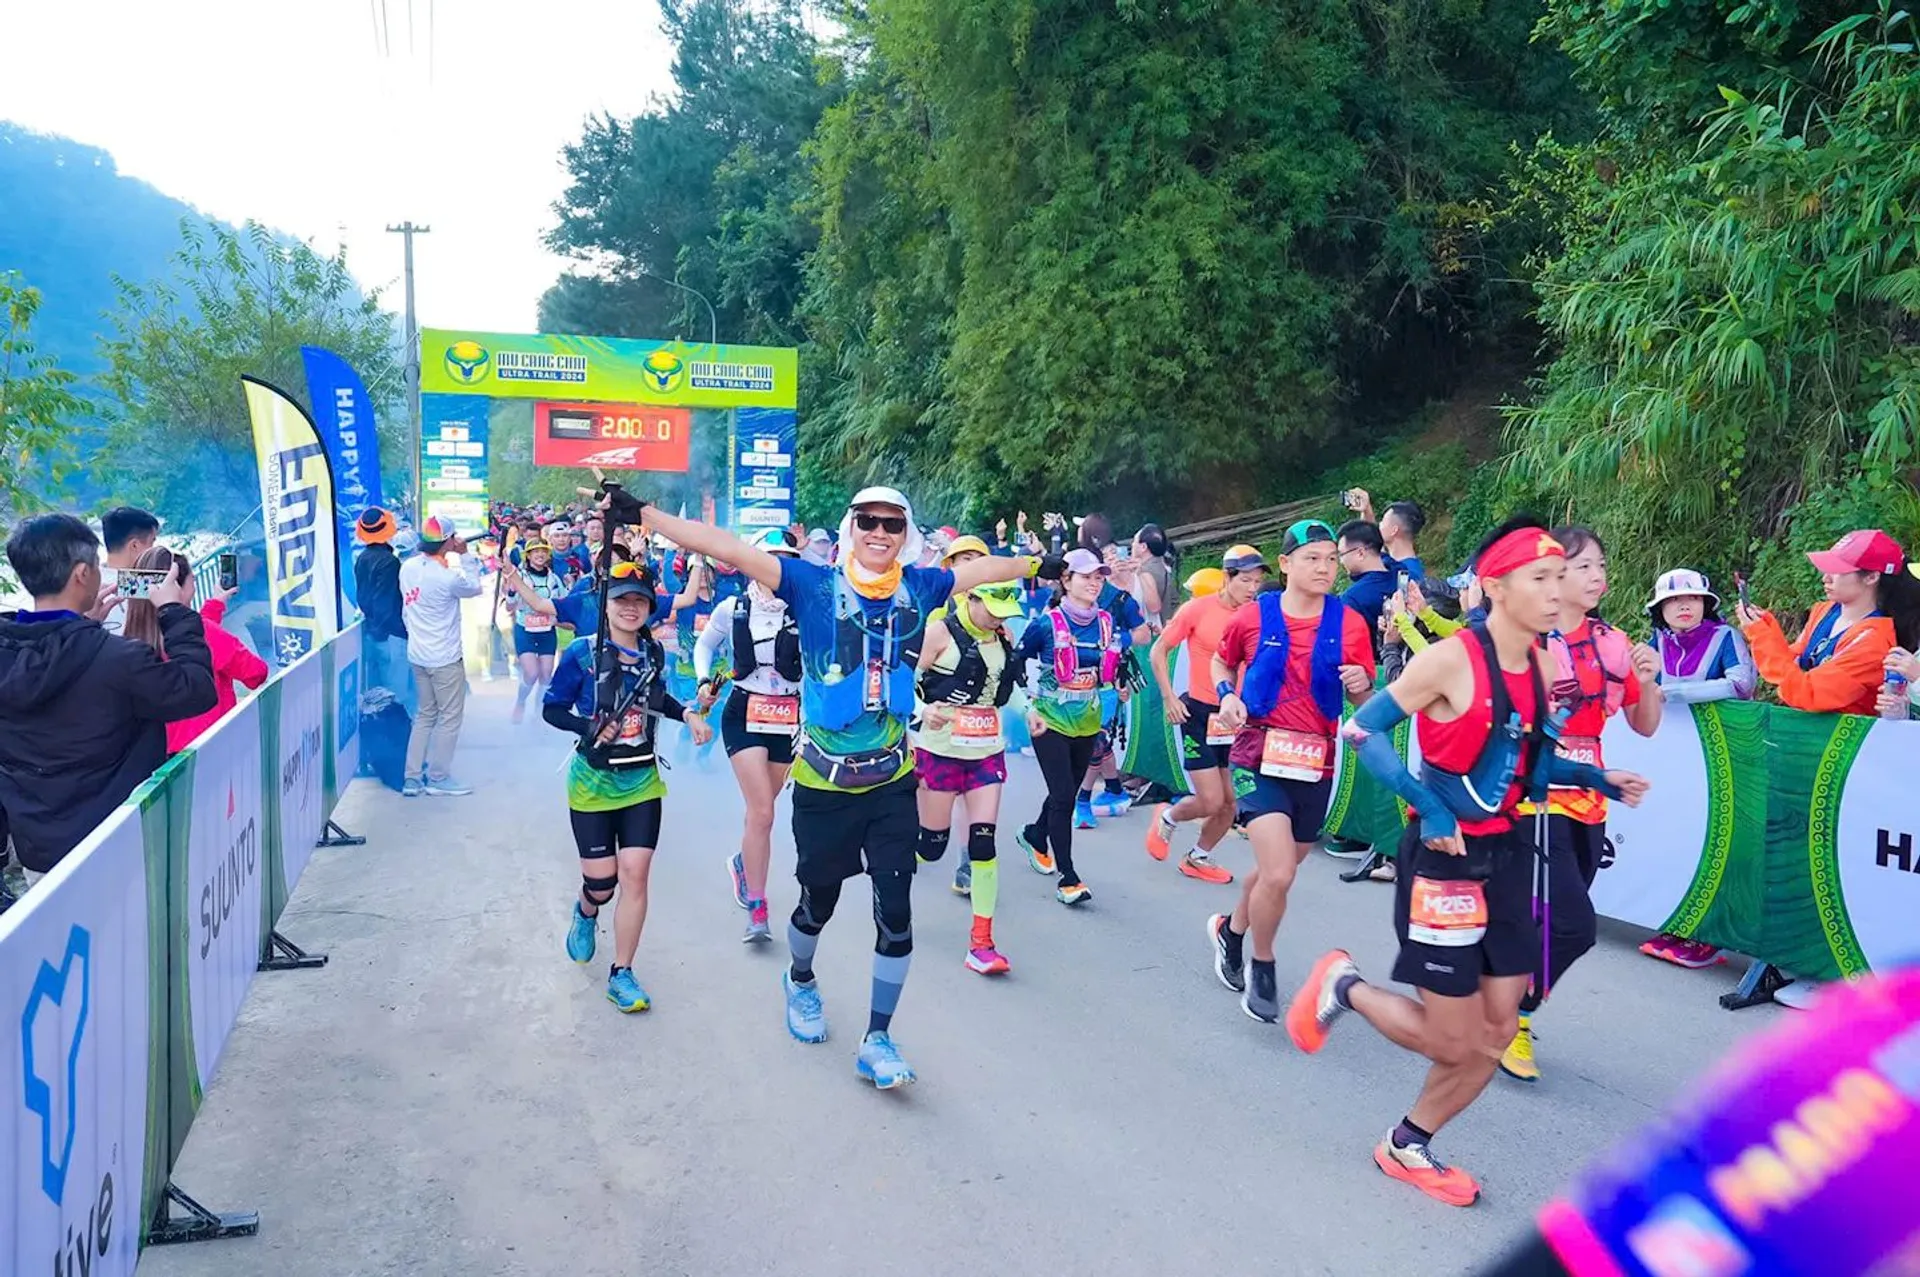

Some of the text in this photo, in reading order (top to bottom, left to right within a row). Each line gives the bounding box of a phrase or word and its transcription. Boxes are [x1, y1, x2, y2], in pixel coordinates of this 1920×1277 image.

[502, 369, 584, 381] ULTRA TRAIL 2024
[694, 378, 771, 390] ULTRA TRAIL 2024
[336, 388, 360, 482] HAPPY
[755, 704, 791, 716] F2746
[960, 716, 995, 729] F2002
[1268, 740, 1323, 759] M4444
[1876, 828, 1920, 875] H
[200, 816, 255, 960] SUUNTO
[1423, 894, 1477, 915] M2153
